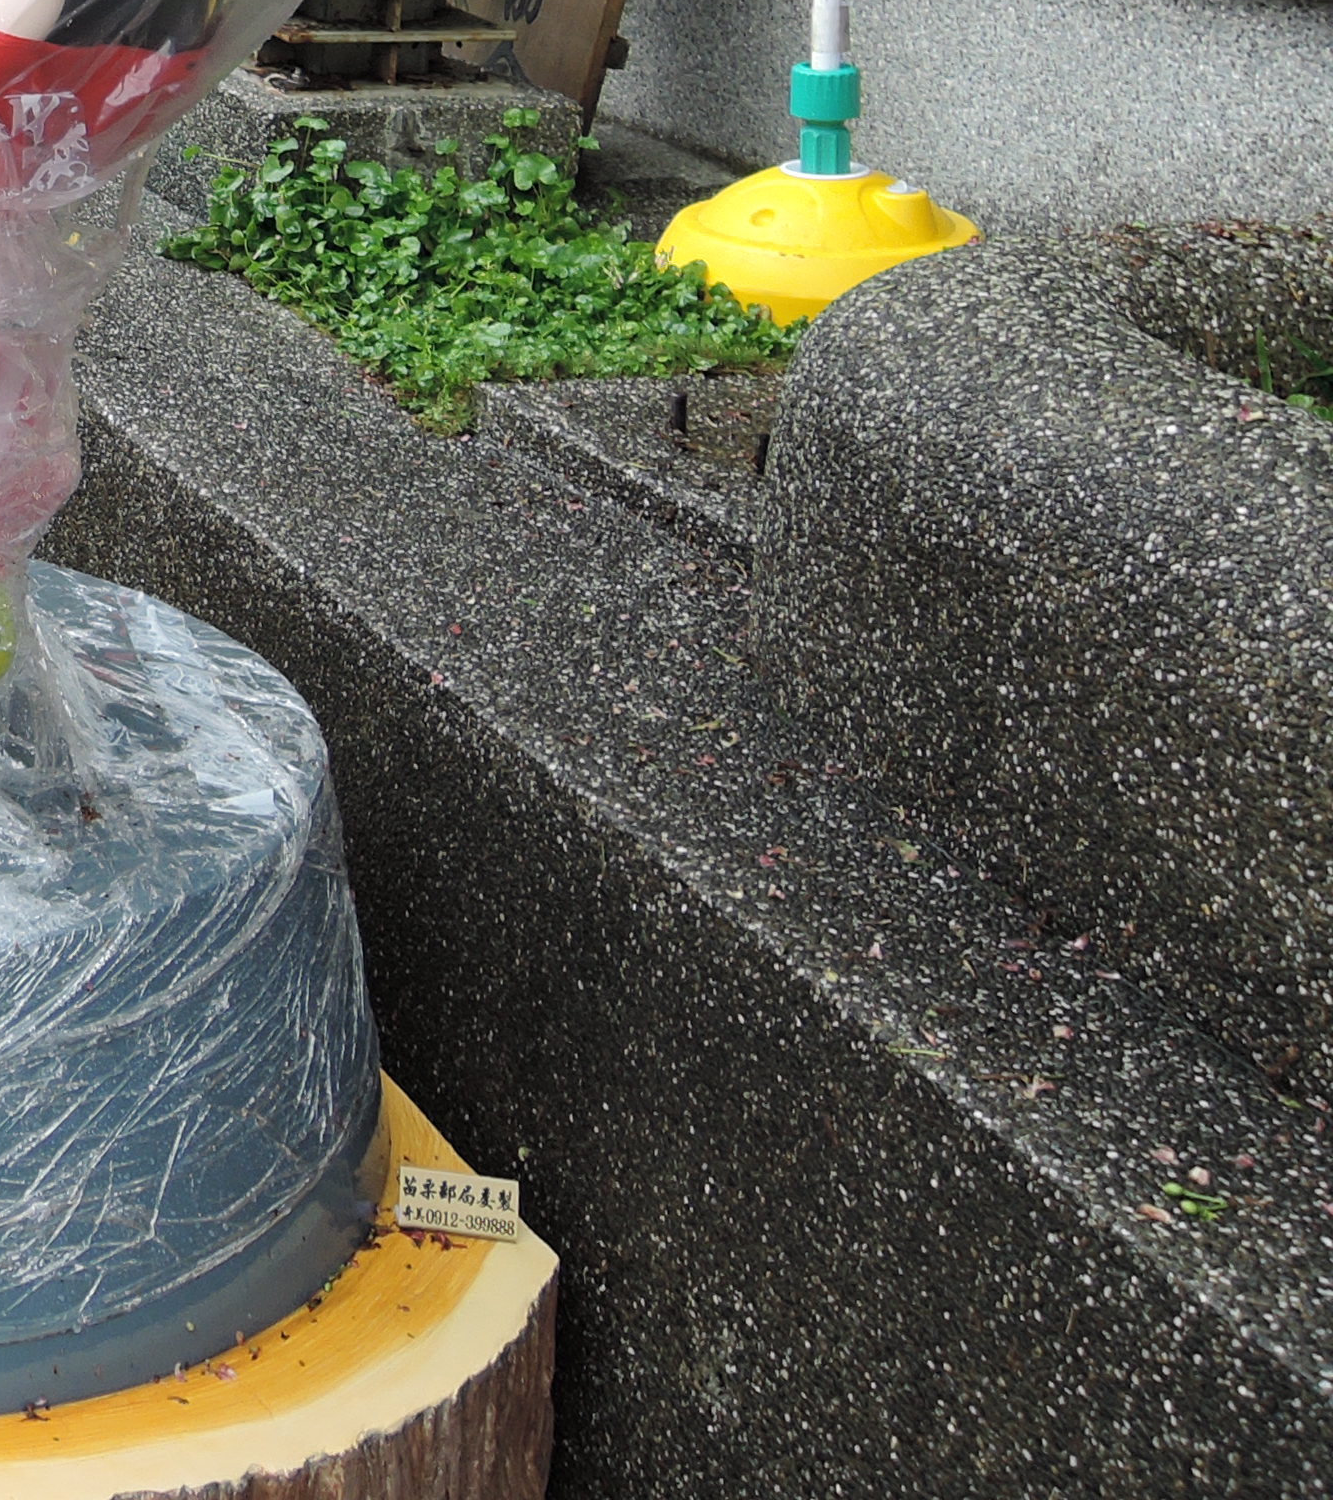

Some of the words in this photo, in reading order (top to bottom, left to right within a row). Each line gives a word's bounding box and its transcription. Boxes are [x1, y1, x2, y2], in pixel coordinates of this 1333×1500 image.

[402, 1175, 516, 1213] 苗栗郵局委製
